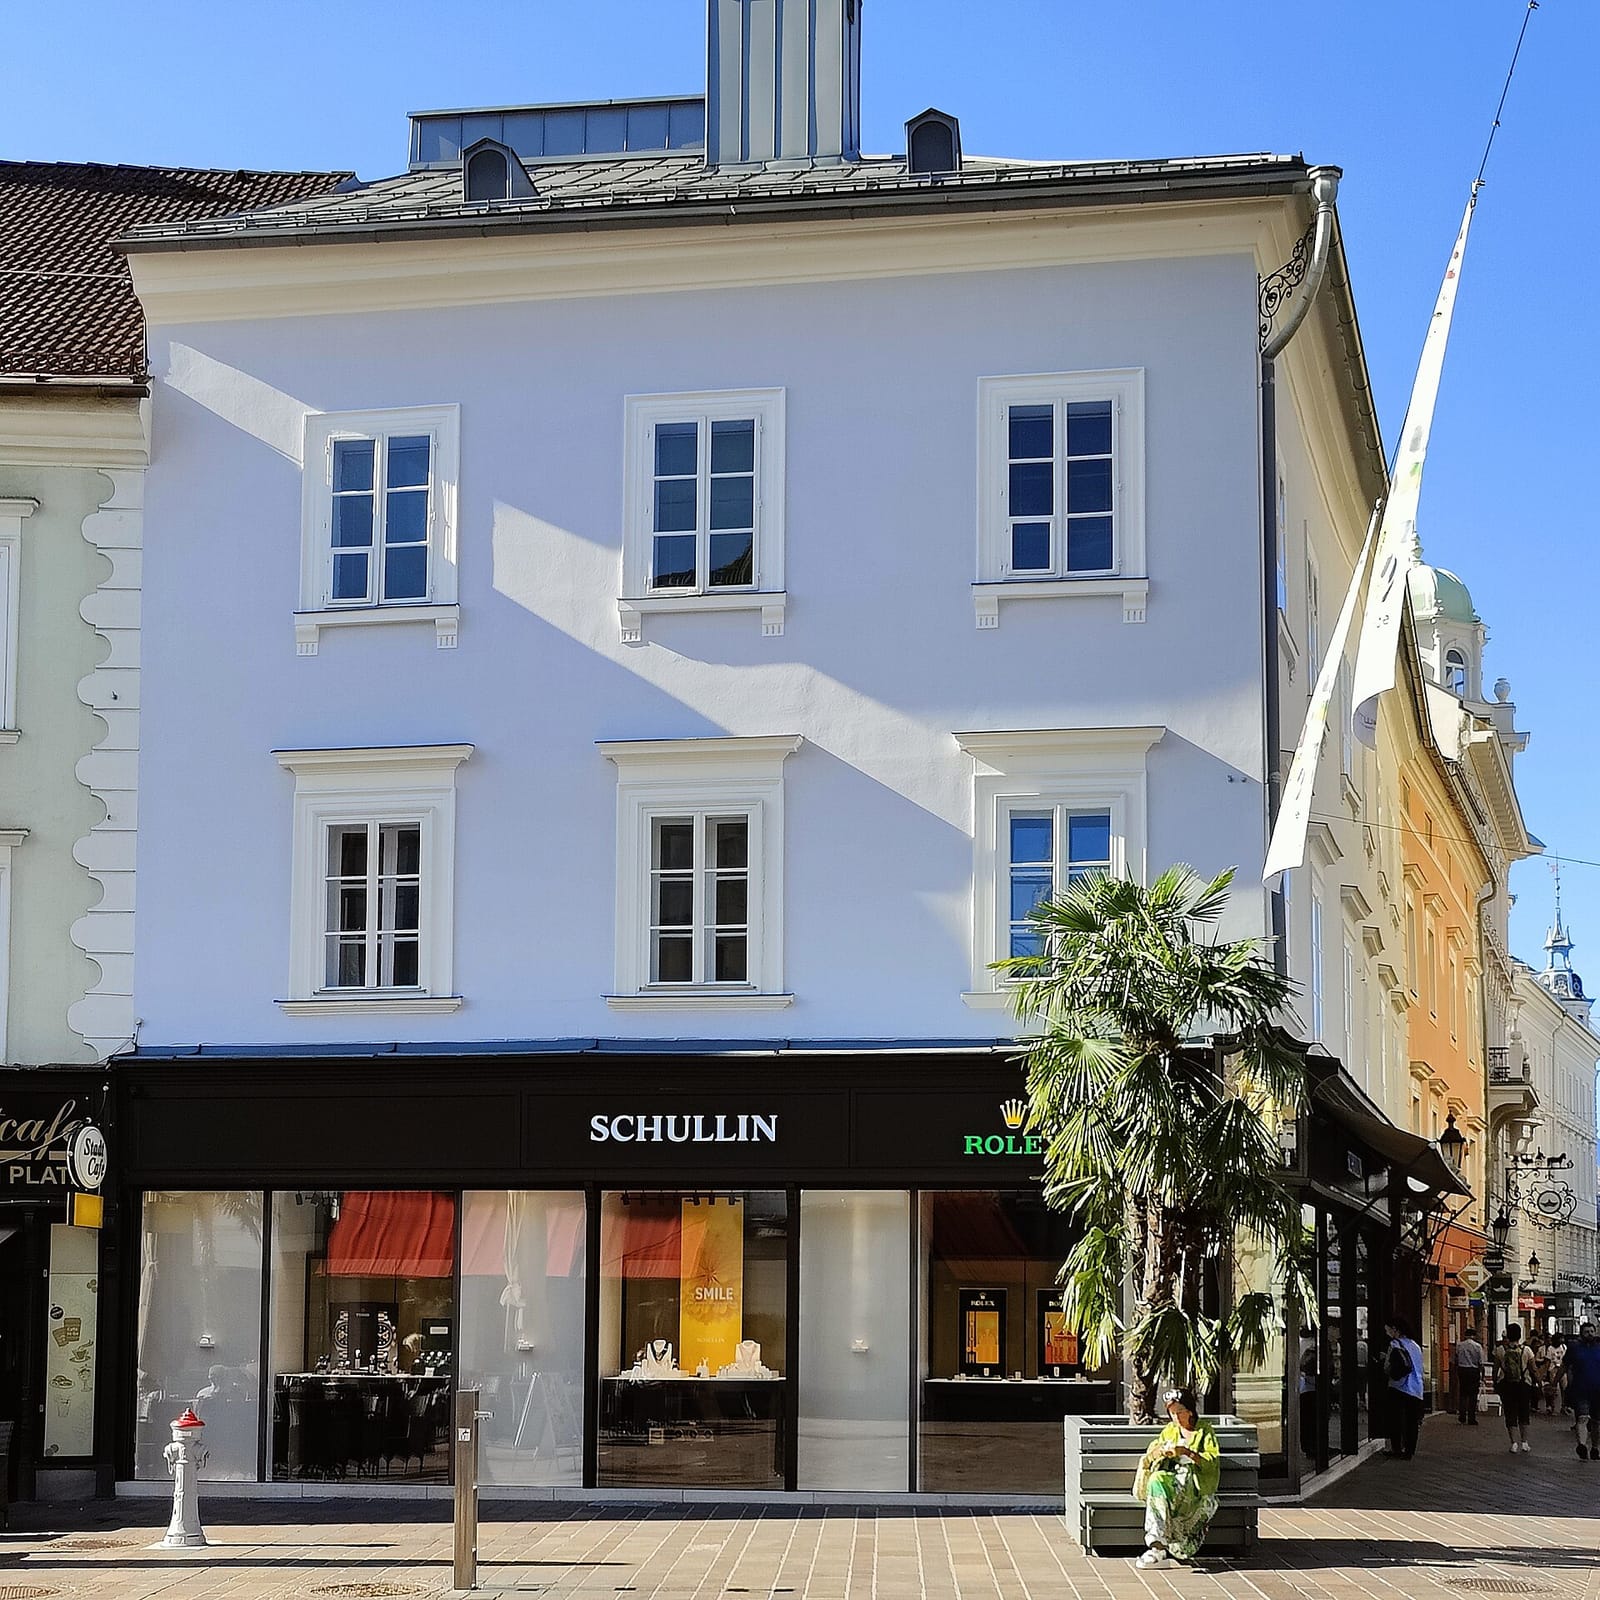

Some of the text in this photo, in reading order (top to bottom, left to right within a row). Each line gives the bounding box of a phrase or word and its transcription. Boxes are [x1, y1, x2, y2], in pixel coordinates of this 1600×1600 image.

[590, 1114, 778, 1142] SCHULLIN
[963, 1135, 1050, 1154] ROLE
[9, 1166, 74, 1185] PLAT
[695, 1287, 734, 1300] SMILE
